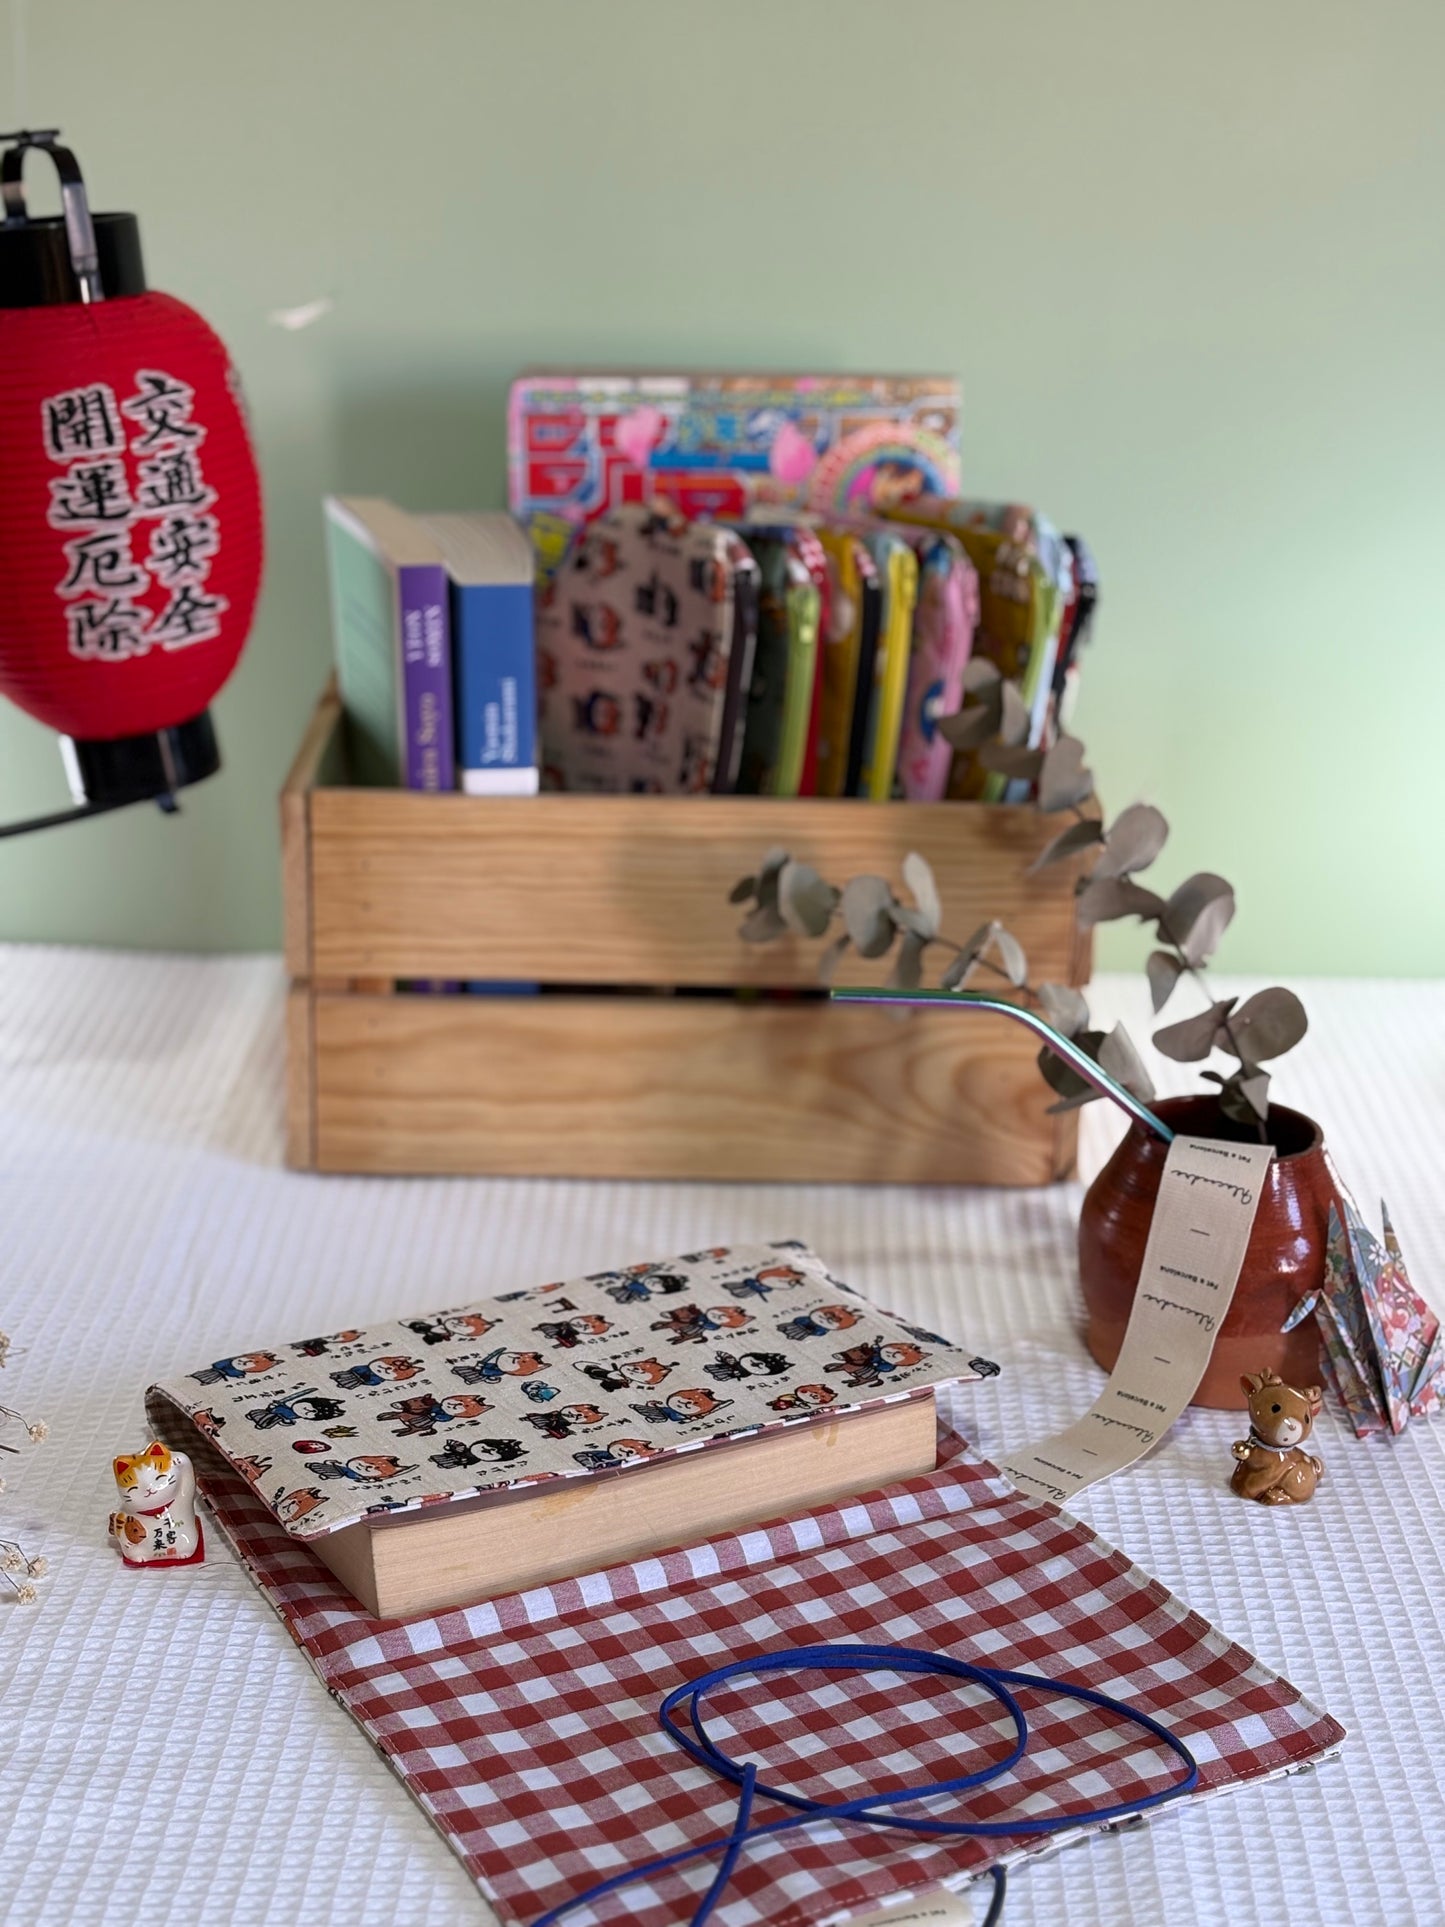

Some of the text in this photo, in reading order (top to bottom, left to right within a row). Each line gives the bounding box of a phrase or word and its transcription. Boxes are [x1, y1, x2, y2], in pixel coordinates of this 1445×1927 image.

[45, 388, 146, 656] 開運厄除
[124, 370, 224, 650] 交通安全
[1189, 1143, 1229, 1157] Barcelona
[1160, 1265, 1198, 1283] Barcelona
[153, 1527, 167, 1551] 万来
